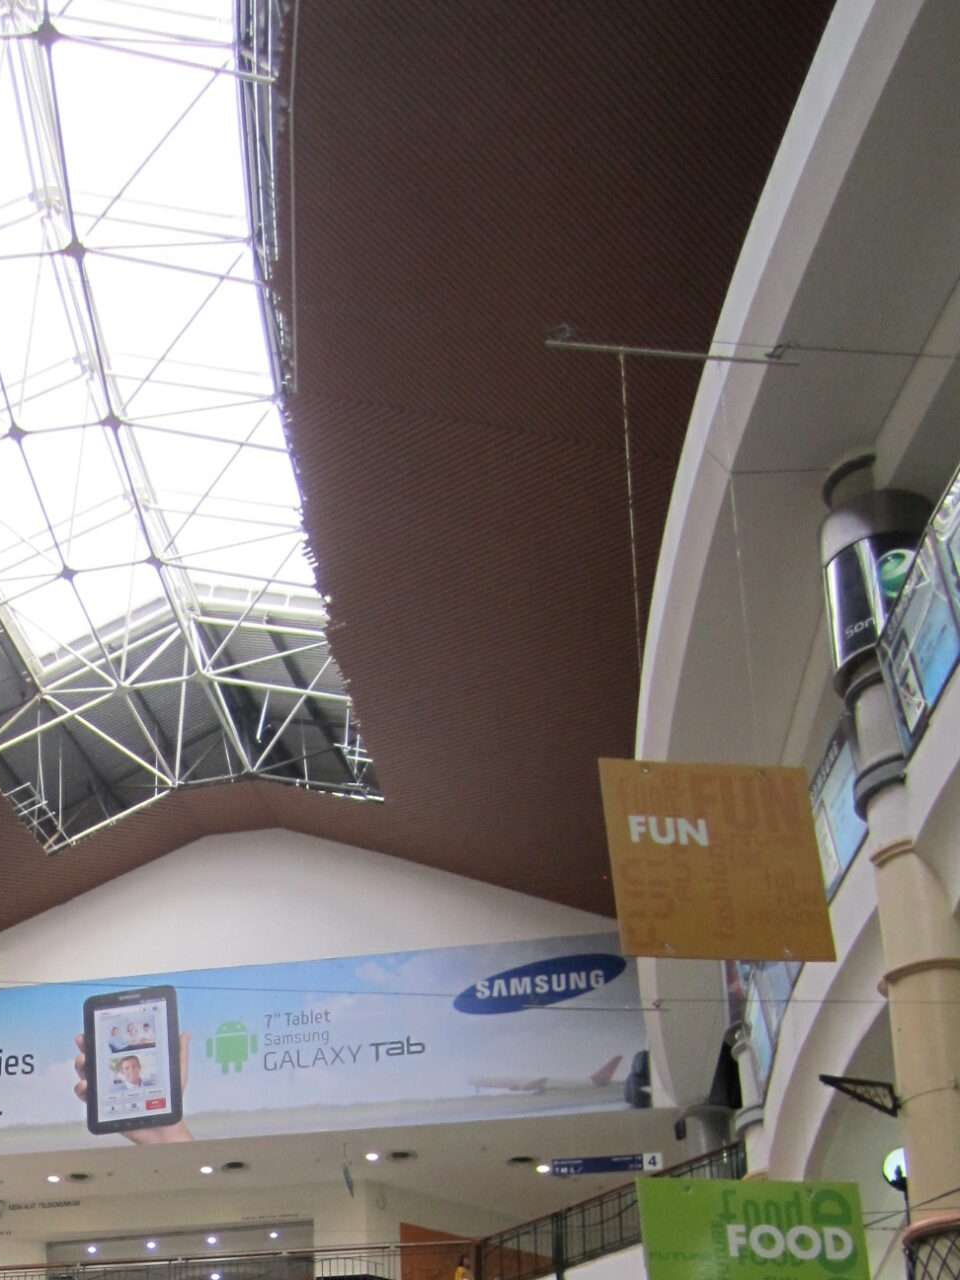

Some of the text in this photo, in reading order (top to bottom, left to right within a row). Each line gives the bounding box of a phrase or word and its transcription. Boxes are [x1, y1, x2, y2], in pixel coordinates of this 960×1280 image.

[627, 815, 709, 847] FUN
[475, 969, 605, 1000] SAMSUNG
[285, 1010, 331, 1027] Tablet
[263, 1035, 426, 1072] GALAXY Tab
[264, 1030, 330, 1047] Samsung
[648, 1155, 658, 1167] 4
[726, 1223, 853, 1261] FOOD
